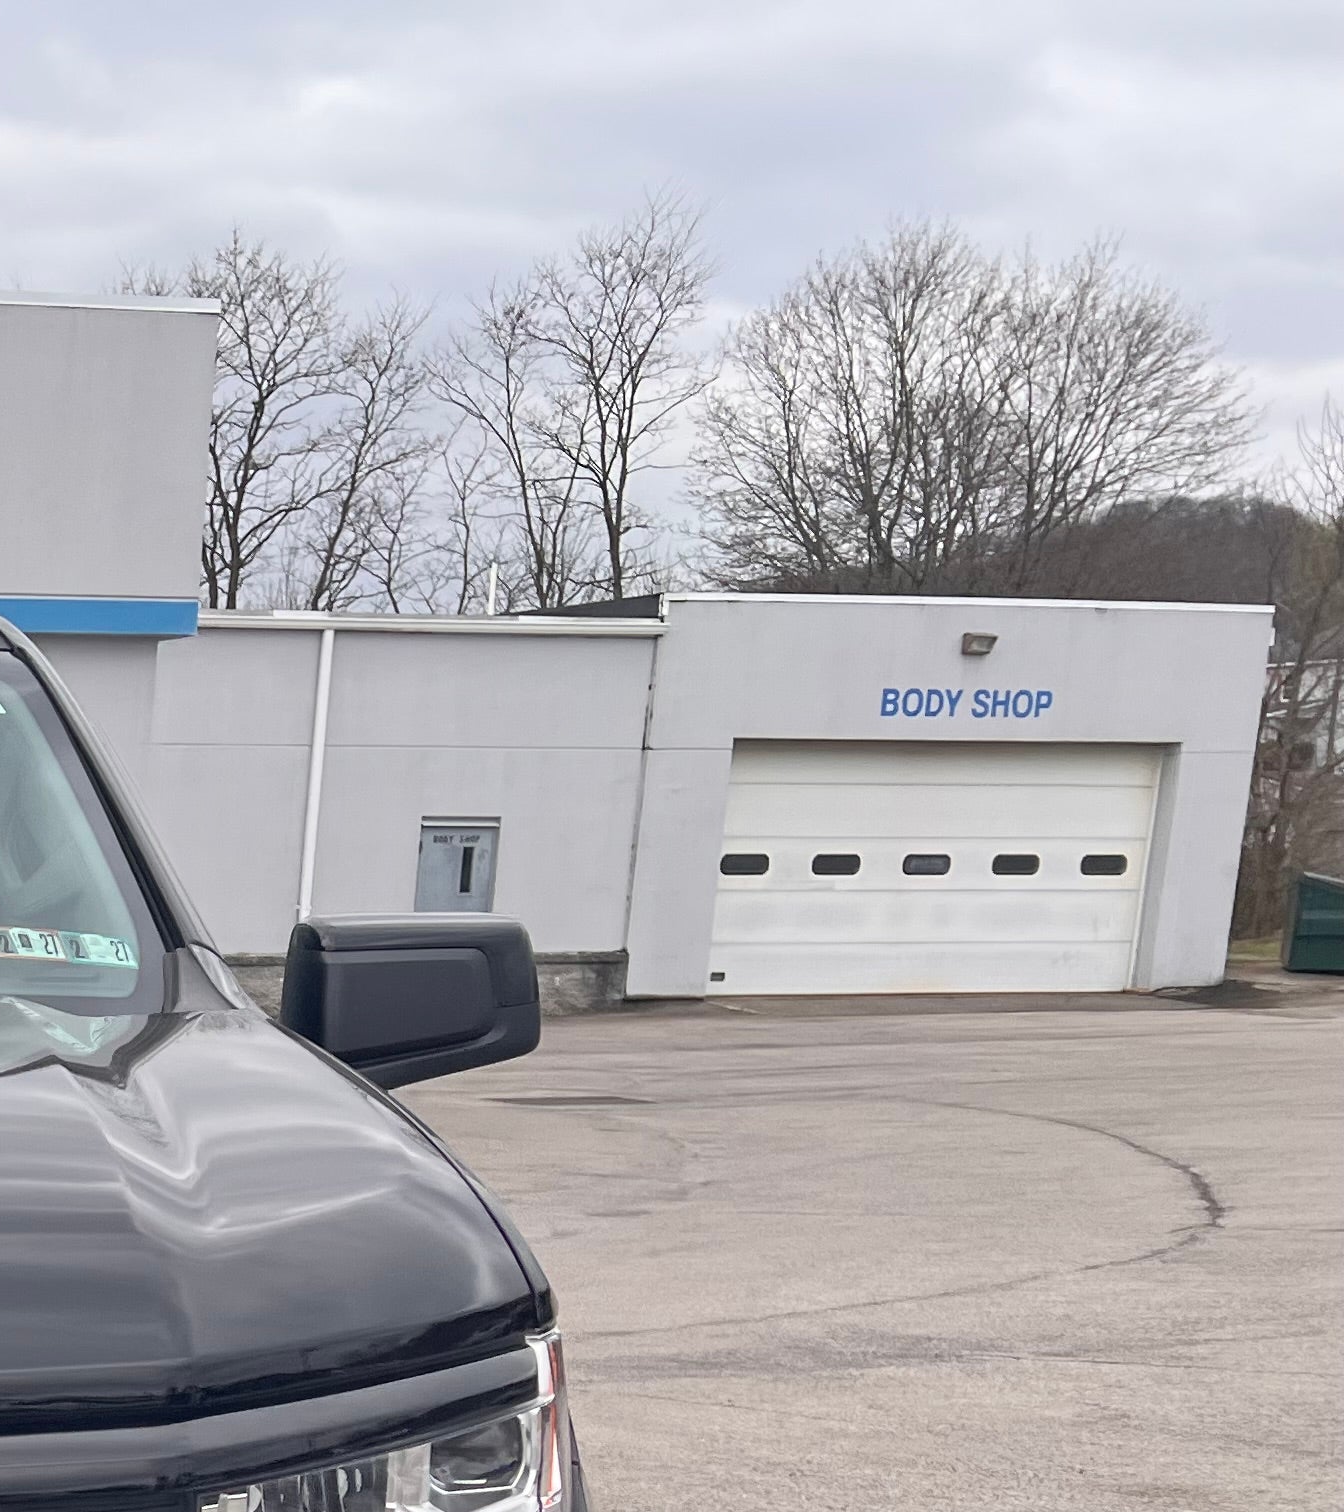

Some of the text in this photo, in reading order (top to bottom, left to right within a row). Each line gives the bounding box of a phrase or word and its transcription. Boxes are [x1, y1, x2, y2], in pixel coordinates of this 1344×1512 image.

[880, 688, 1053, 718] BODY SHOP
[39, 933, 59, 957] 27
[69, 939, 130, 963] 2 27
